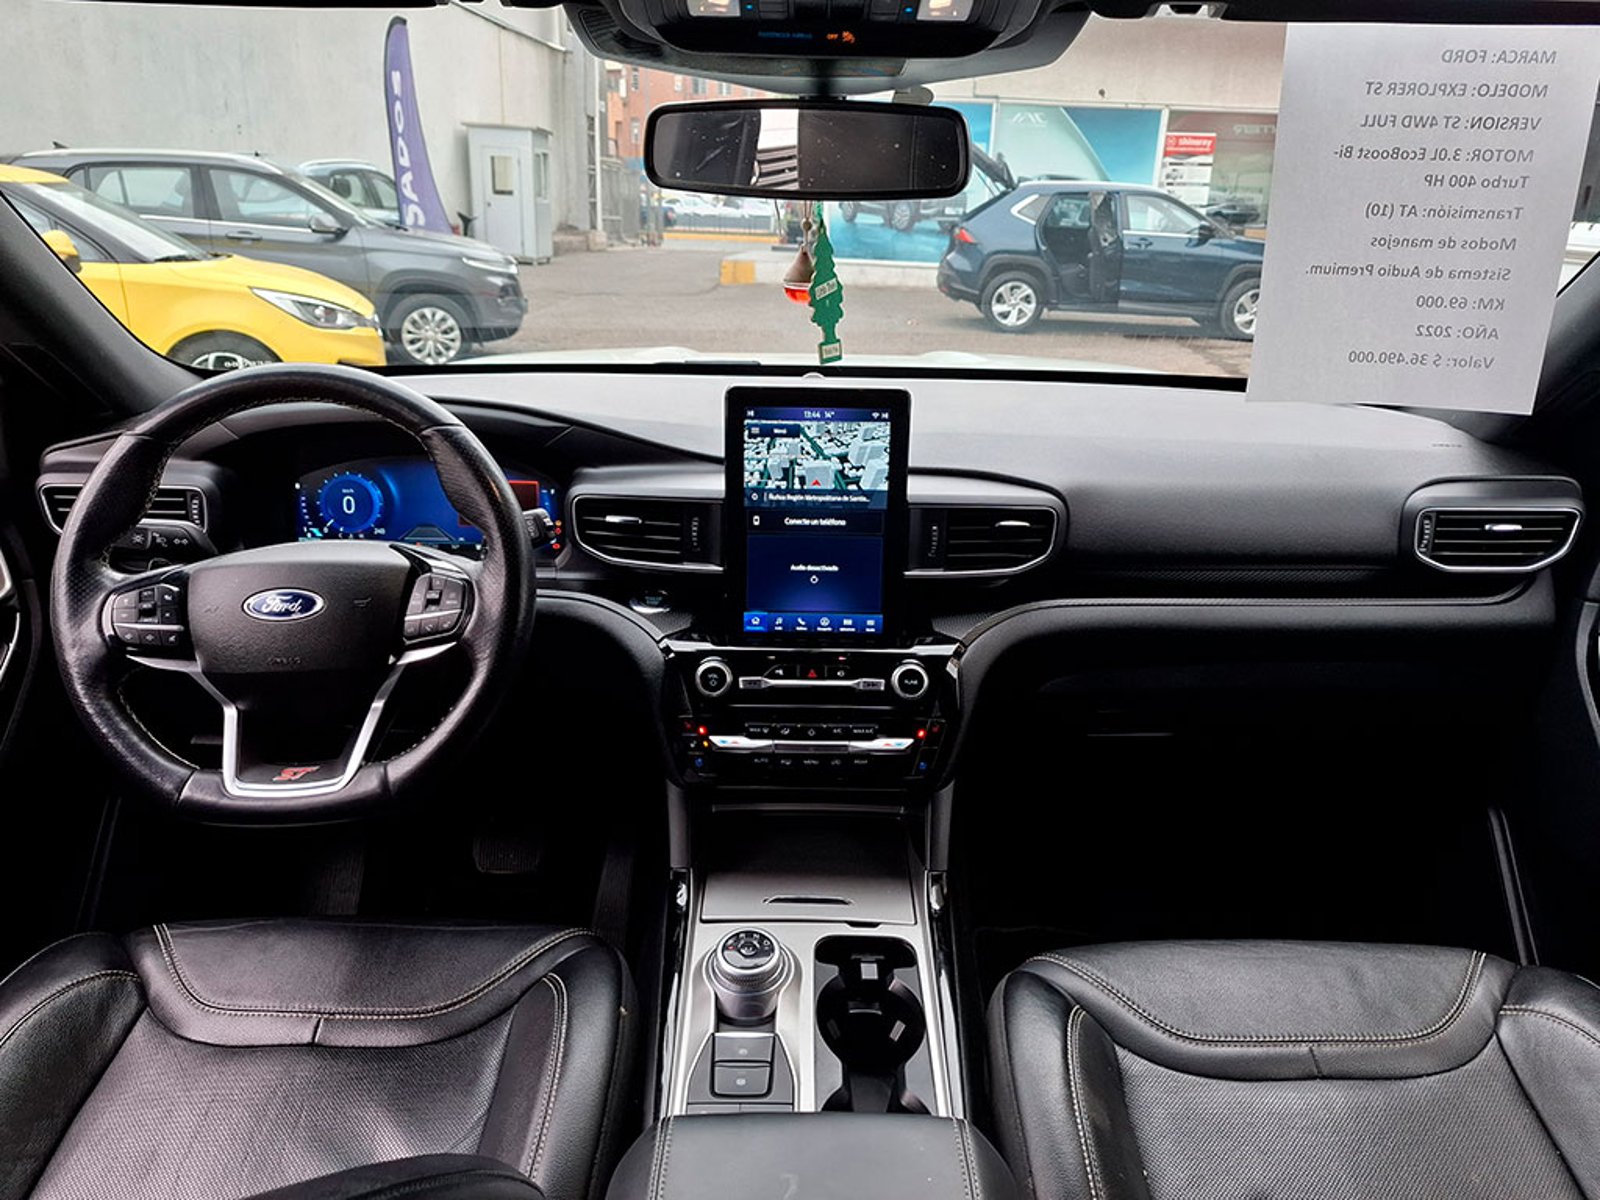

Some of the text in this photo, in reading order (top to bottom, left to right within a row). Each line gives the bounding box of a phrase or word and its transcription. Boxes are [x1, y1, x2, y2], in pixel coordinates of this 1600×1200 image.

[343, 495, 355, 514] 0
[260, 593, 305, 613] Ford
[272, 765, 321, 782] ST
